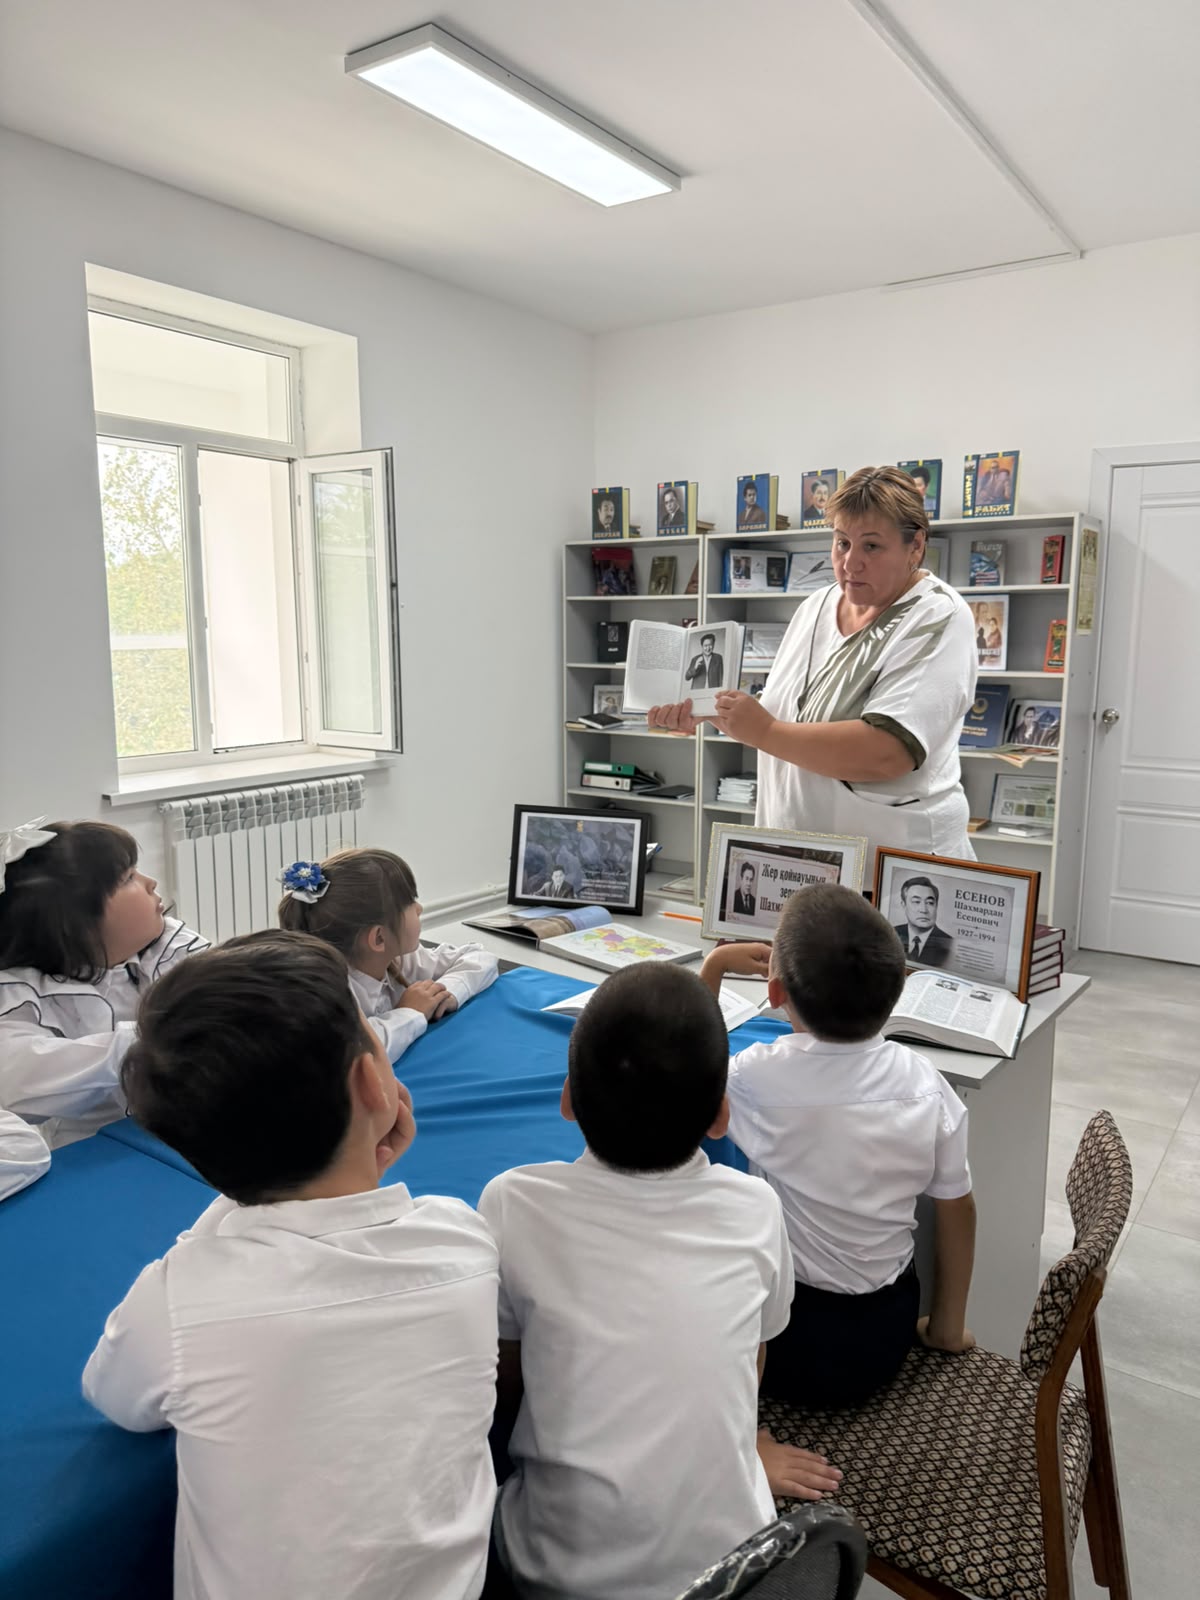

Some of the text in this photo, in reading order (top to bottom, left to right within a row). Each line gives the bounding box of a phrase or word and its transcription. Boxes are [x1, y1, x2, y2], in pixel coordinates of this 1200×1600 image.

[761, 863, 779, 882] Жер
[955, 889, 1005, 907] ЕСЕНОВ
[954, 900, 1004, 918] Шахмардан
[956, 911, 999, 927] Есенович
